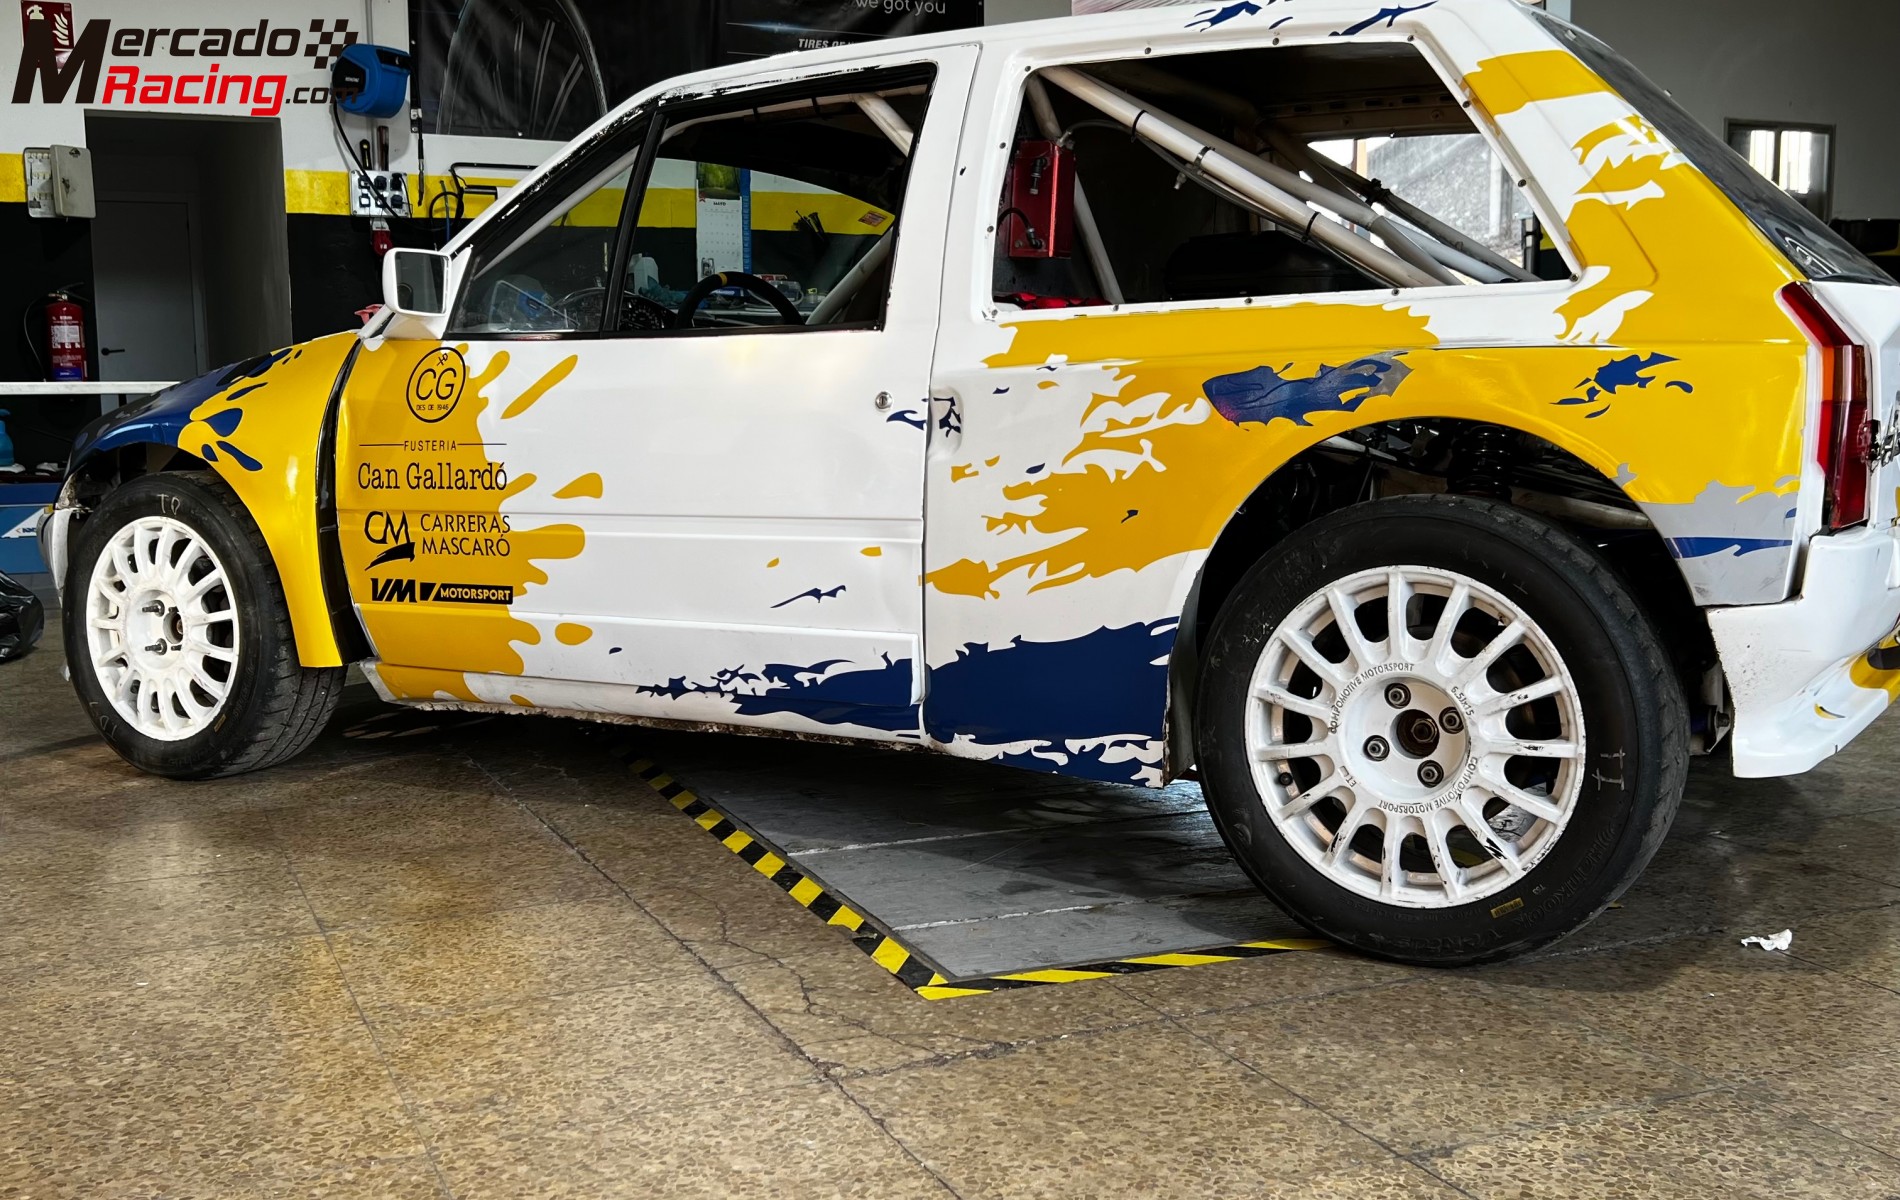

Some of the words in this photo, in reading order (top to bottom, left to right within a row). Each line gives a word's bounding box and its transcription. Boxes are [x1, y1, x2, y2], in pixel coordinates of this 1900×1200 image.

[915, 0, 946, 16] you
[798, 38, 828, 49] TIRES
[416, 367, 457, 401] CG
[403, 440, 457, 451] FUSTERIA
[358, 462, 401, 490] Can
[406, 461, 508, 491] Gallardó
[420, 513, 511, 534] CARRERAS
[421, 534, 511, 557] MASCARÓ
[370, 577, 418, 604] VM
[440, 587, 511, 601] MOTORSPORT
[1360, 662, 1415, 681] MOTORSPORT
[1377, 799, 1434, 814] MOTORSPORT
